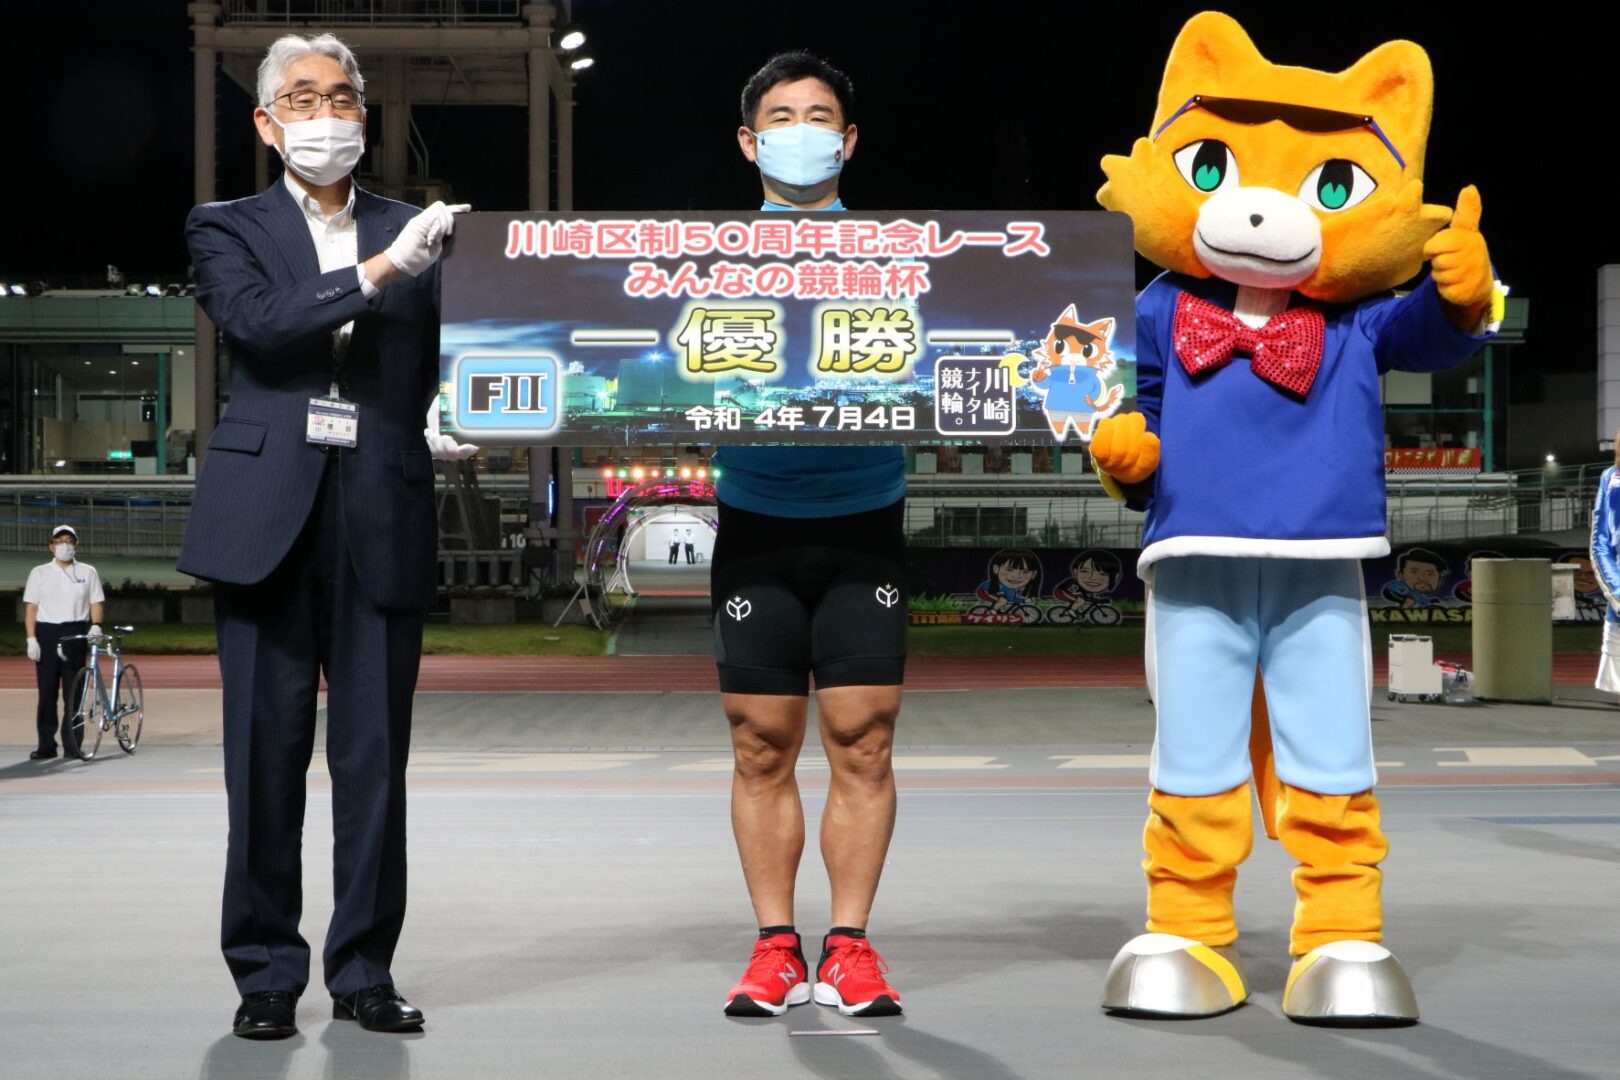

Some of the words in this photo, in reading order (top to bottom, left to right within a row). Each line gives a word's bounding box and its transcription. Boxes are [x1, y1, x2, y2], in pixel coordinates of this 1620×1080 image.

[506, 219, 1050, 258] 川崎区制50周年記念レース
[624, 261, 931, 298] みんなの競輪杯
[677, 306, 917, 373] 優勝
[685, 406, 740, 431] 令和
[965, 367, 981, 425] ナイター
[983, 367, 1010, 424] 川崎
